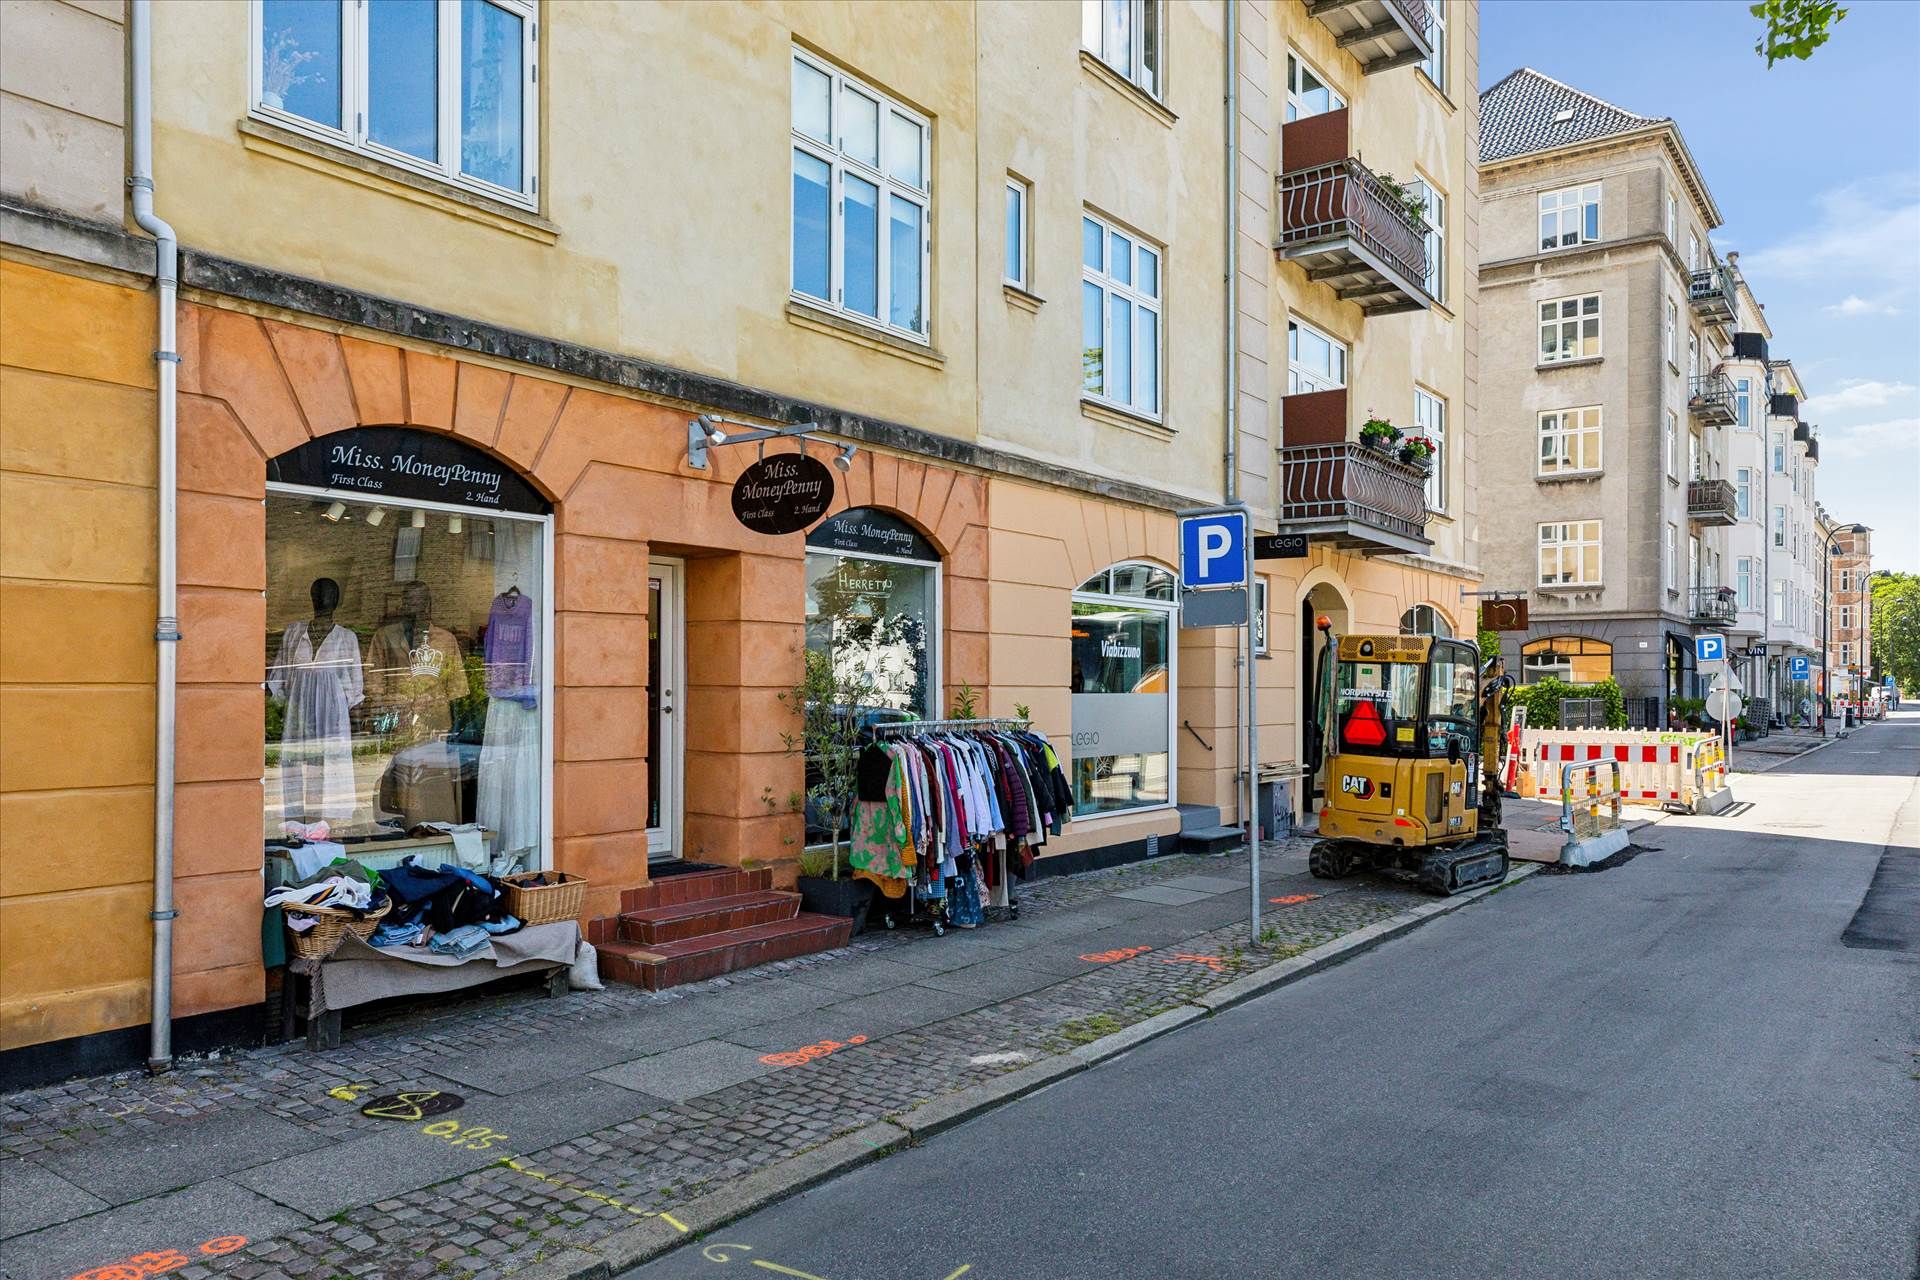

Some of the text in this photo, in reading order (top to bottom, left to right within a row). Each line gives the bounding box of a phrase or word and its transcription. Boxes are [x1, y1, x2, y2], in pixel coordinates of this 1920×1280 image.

[331, 445, 501, 493] Miss. MoneyPenny
[764, 461, 799, 480] Miss.
[331, 473, 383, 489] First Class
[475, 492, 501, 505] Hand
[742, 479, 823, 503] MoneyPenny
[742, 508, 775, 521] First Class
[801, 503, 821, 514] Hand
[833, 519, 914, 548] Miss. MoneyPenny
[1198, 524, 1232, 578] P
[1101, 639, 1141, 659] Viabizzuno
[1703, 640, 1718, 658] P
[1748, 647, 1764, 655] VIN
[1795, 659, 1805, 671] P
[1342, 775, 1367, 794] CAT
